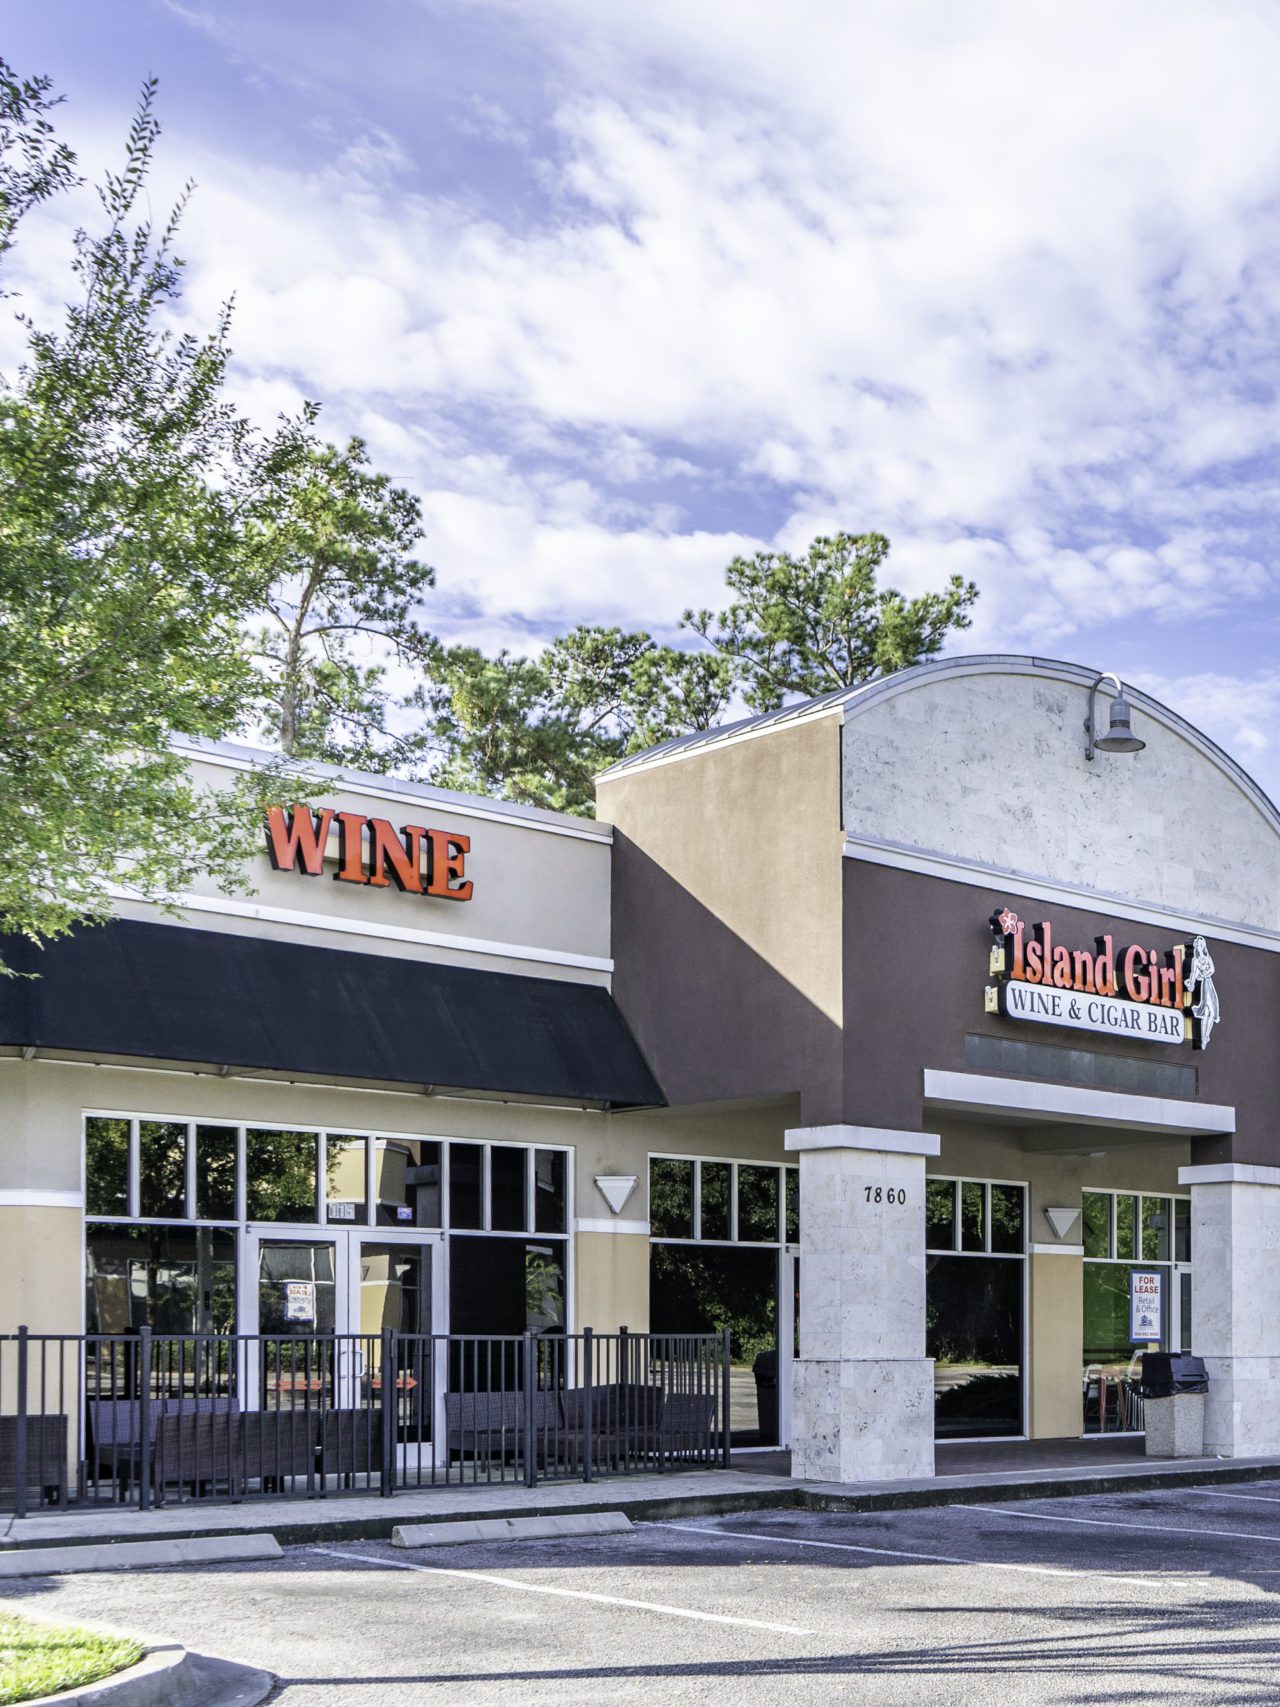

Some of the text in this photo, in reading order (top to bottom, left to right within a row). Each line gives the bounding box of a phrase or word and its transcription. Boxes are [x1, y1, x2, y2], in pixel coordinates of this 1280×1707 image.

[264, 802, 474, 901] WINE
[1010, 921, 1185, 1010] Island Girl
[1011, 988, 1181, 1037] WINE & CIGAR BAR
[864, 1185, 906, 1205] 7860
[1139, 1277, 1155, 1285] FOR
[1134, 1285, 1159, 1294] LEASE
[1138, 1296, 1155, 1305] Retail
[1136, 1304, 1159, 1314] & Office
